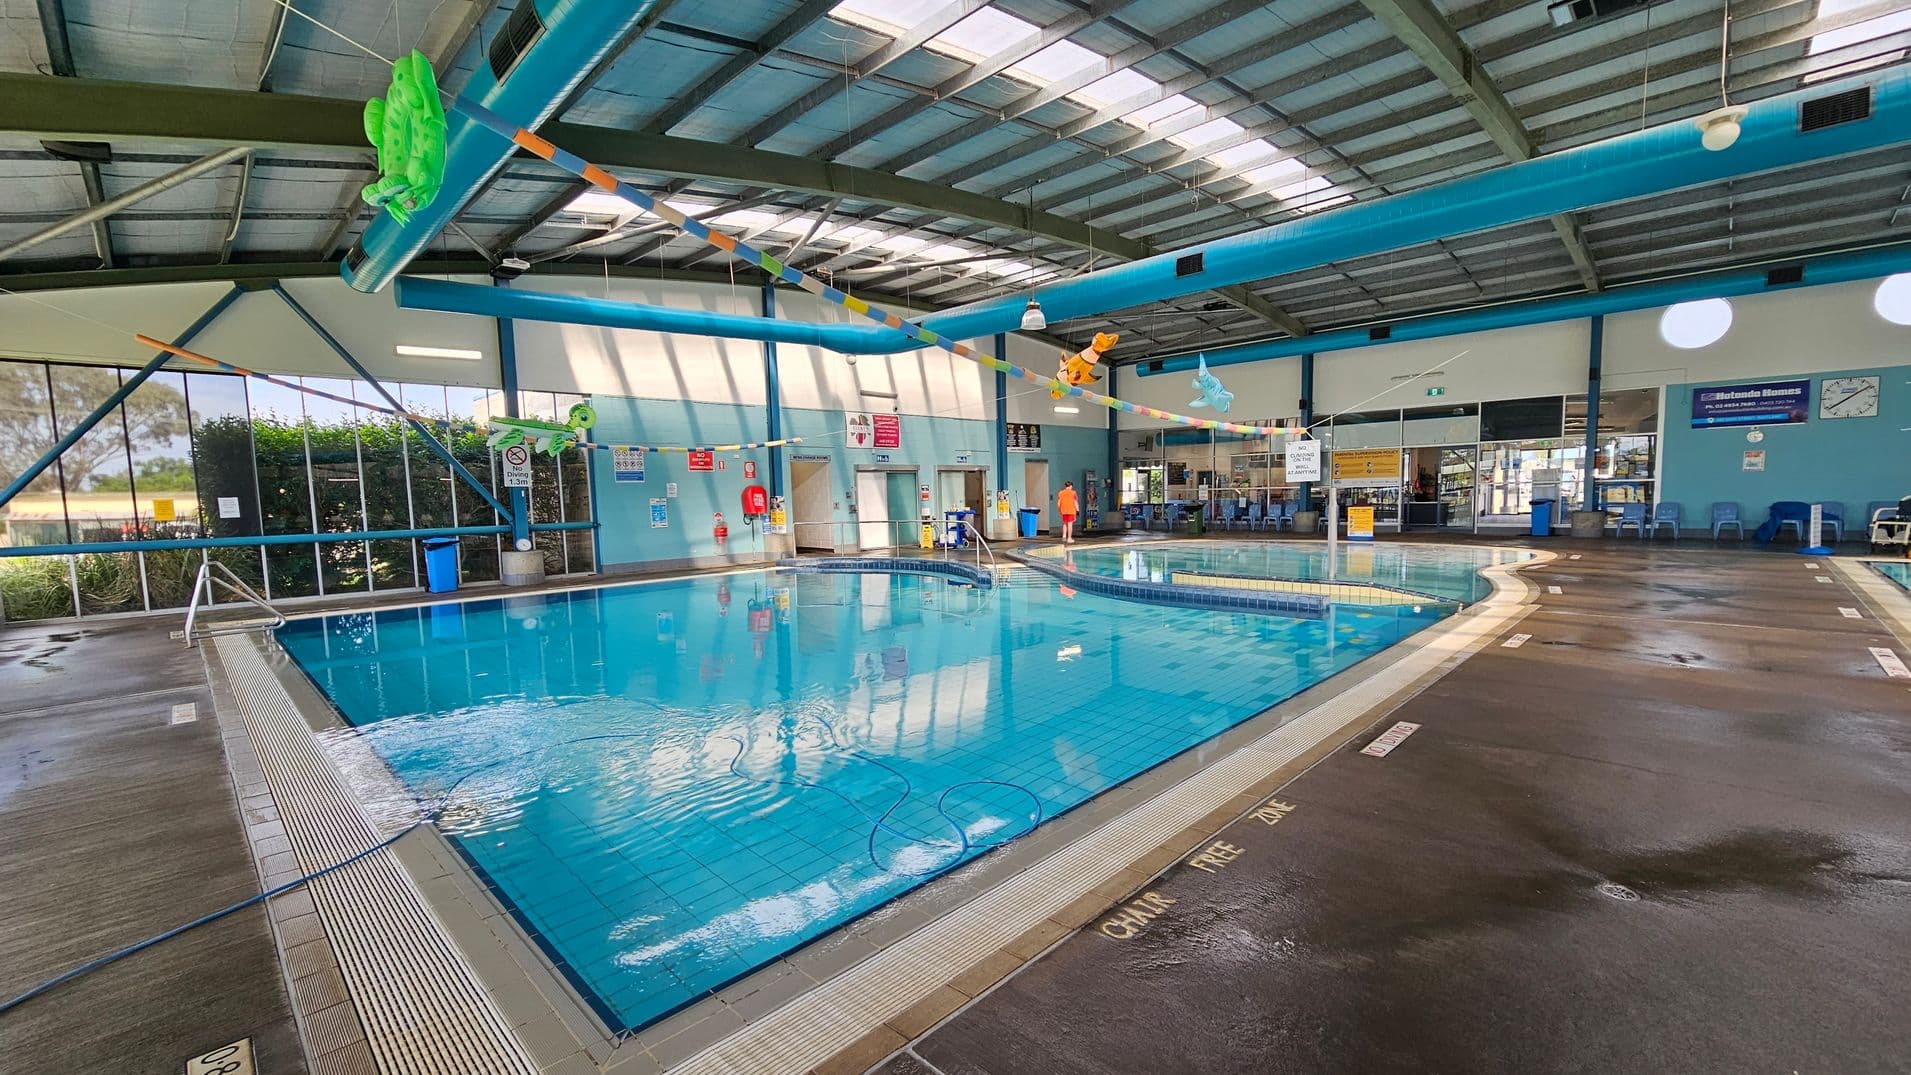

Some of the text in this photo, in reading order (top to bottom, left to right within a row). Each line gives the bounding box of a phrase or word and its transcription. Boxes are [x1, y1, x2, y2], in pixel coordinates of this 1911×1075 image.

[1762, 387, 1802, 397] Homes
[1375, 725, 1413, 747] DIVING
[1102, 799, 1297, 940] CHAIR FREE ZONE
